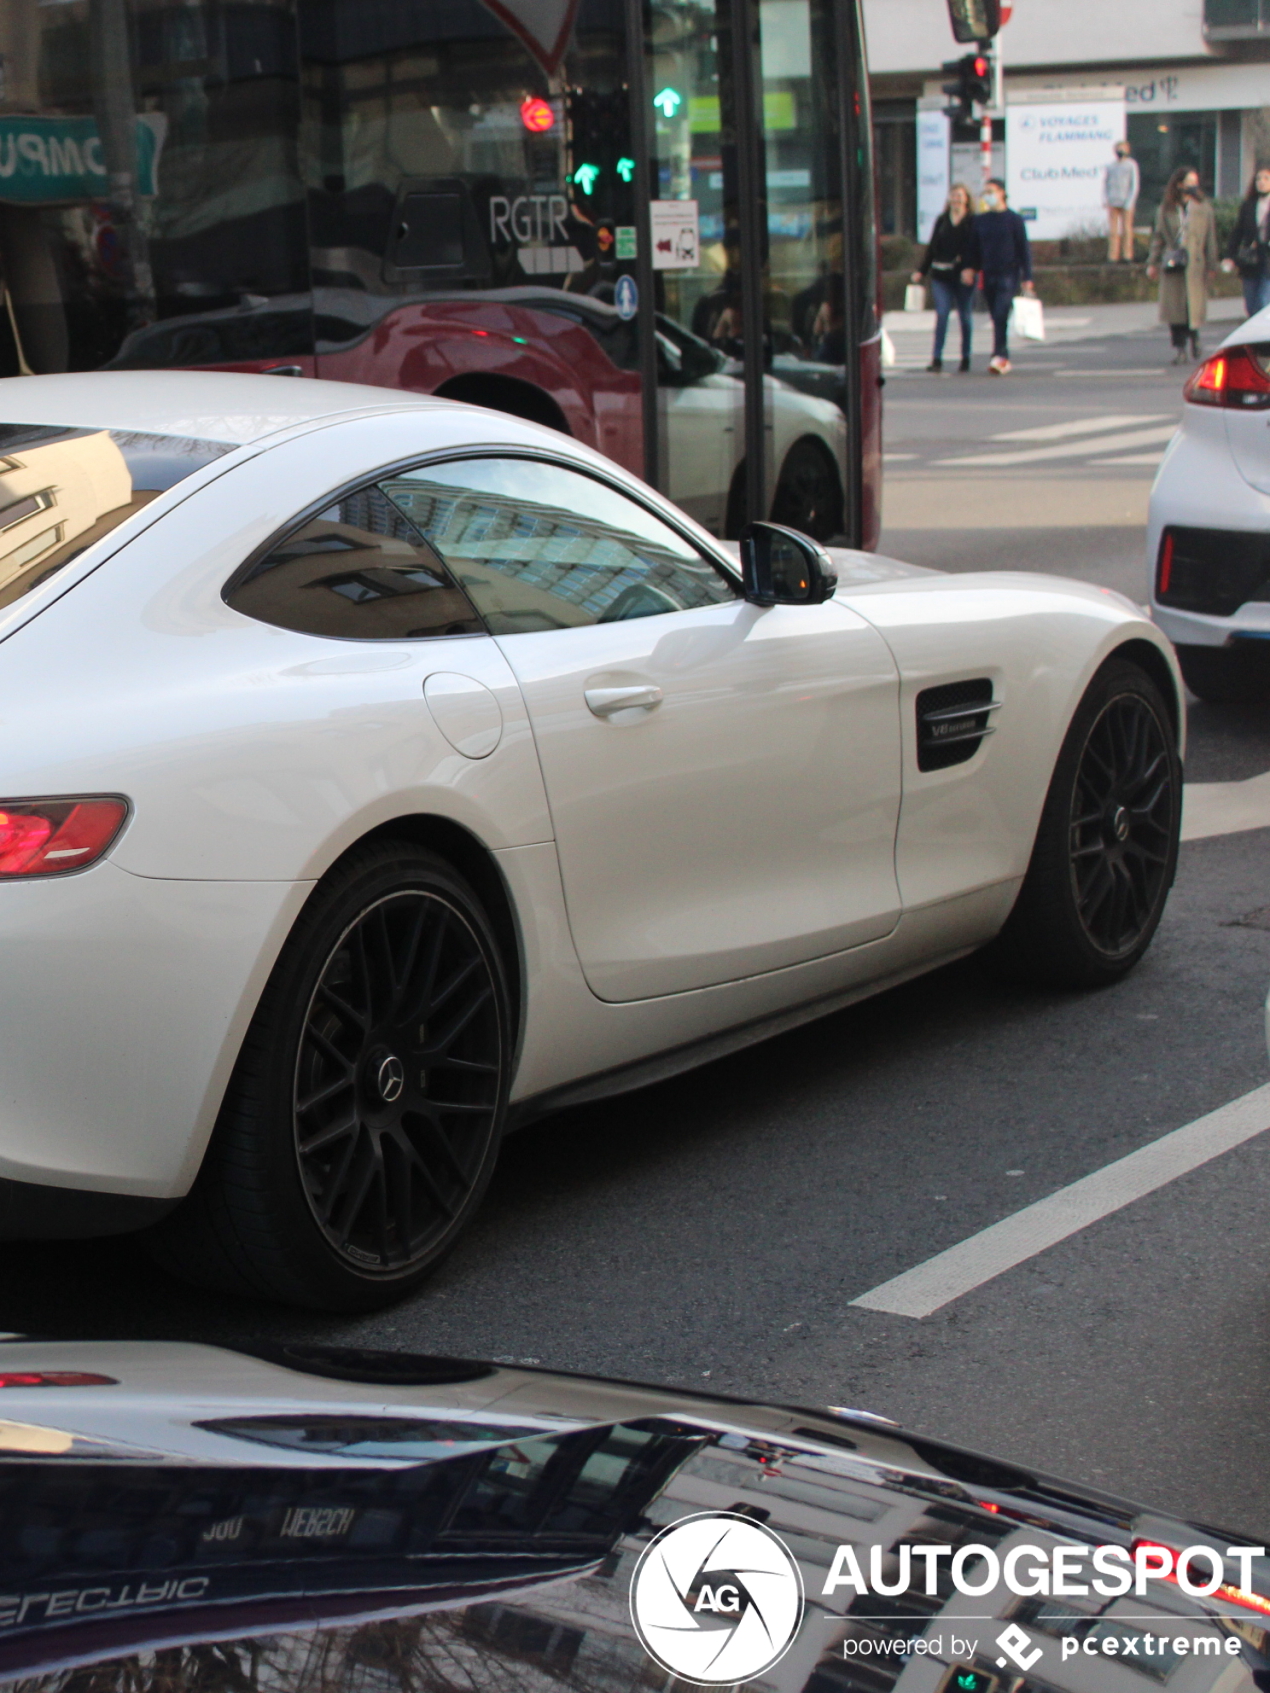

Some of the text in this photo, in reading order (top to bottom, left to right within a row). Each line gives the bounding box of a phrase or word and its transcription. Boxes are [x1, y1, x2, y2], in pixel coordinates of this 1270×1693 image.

[1039, 115, 1100, 128] VOYAGES
[1038, 130, 1114, 142] FLAMMANG
[1020, 165, 1099, 180] Club Med
[489, 195, 569, 243] RGTR
